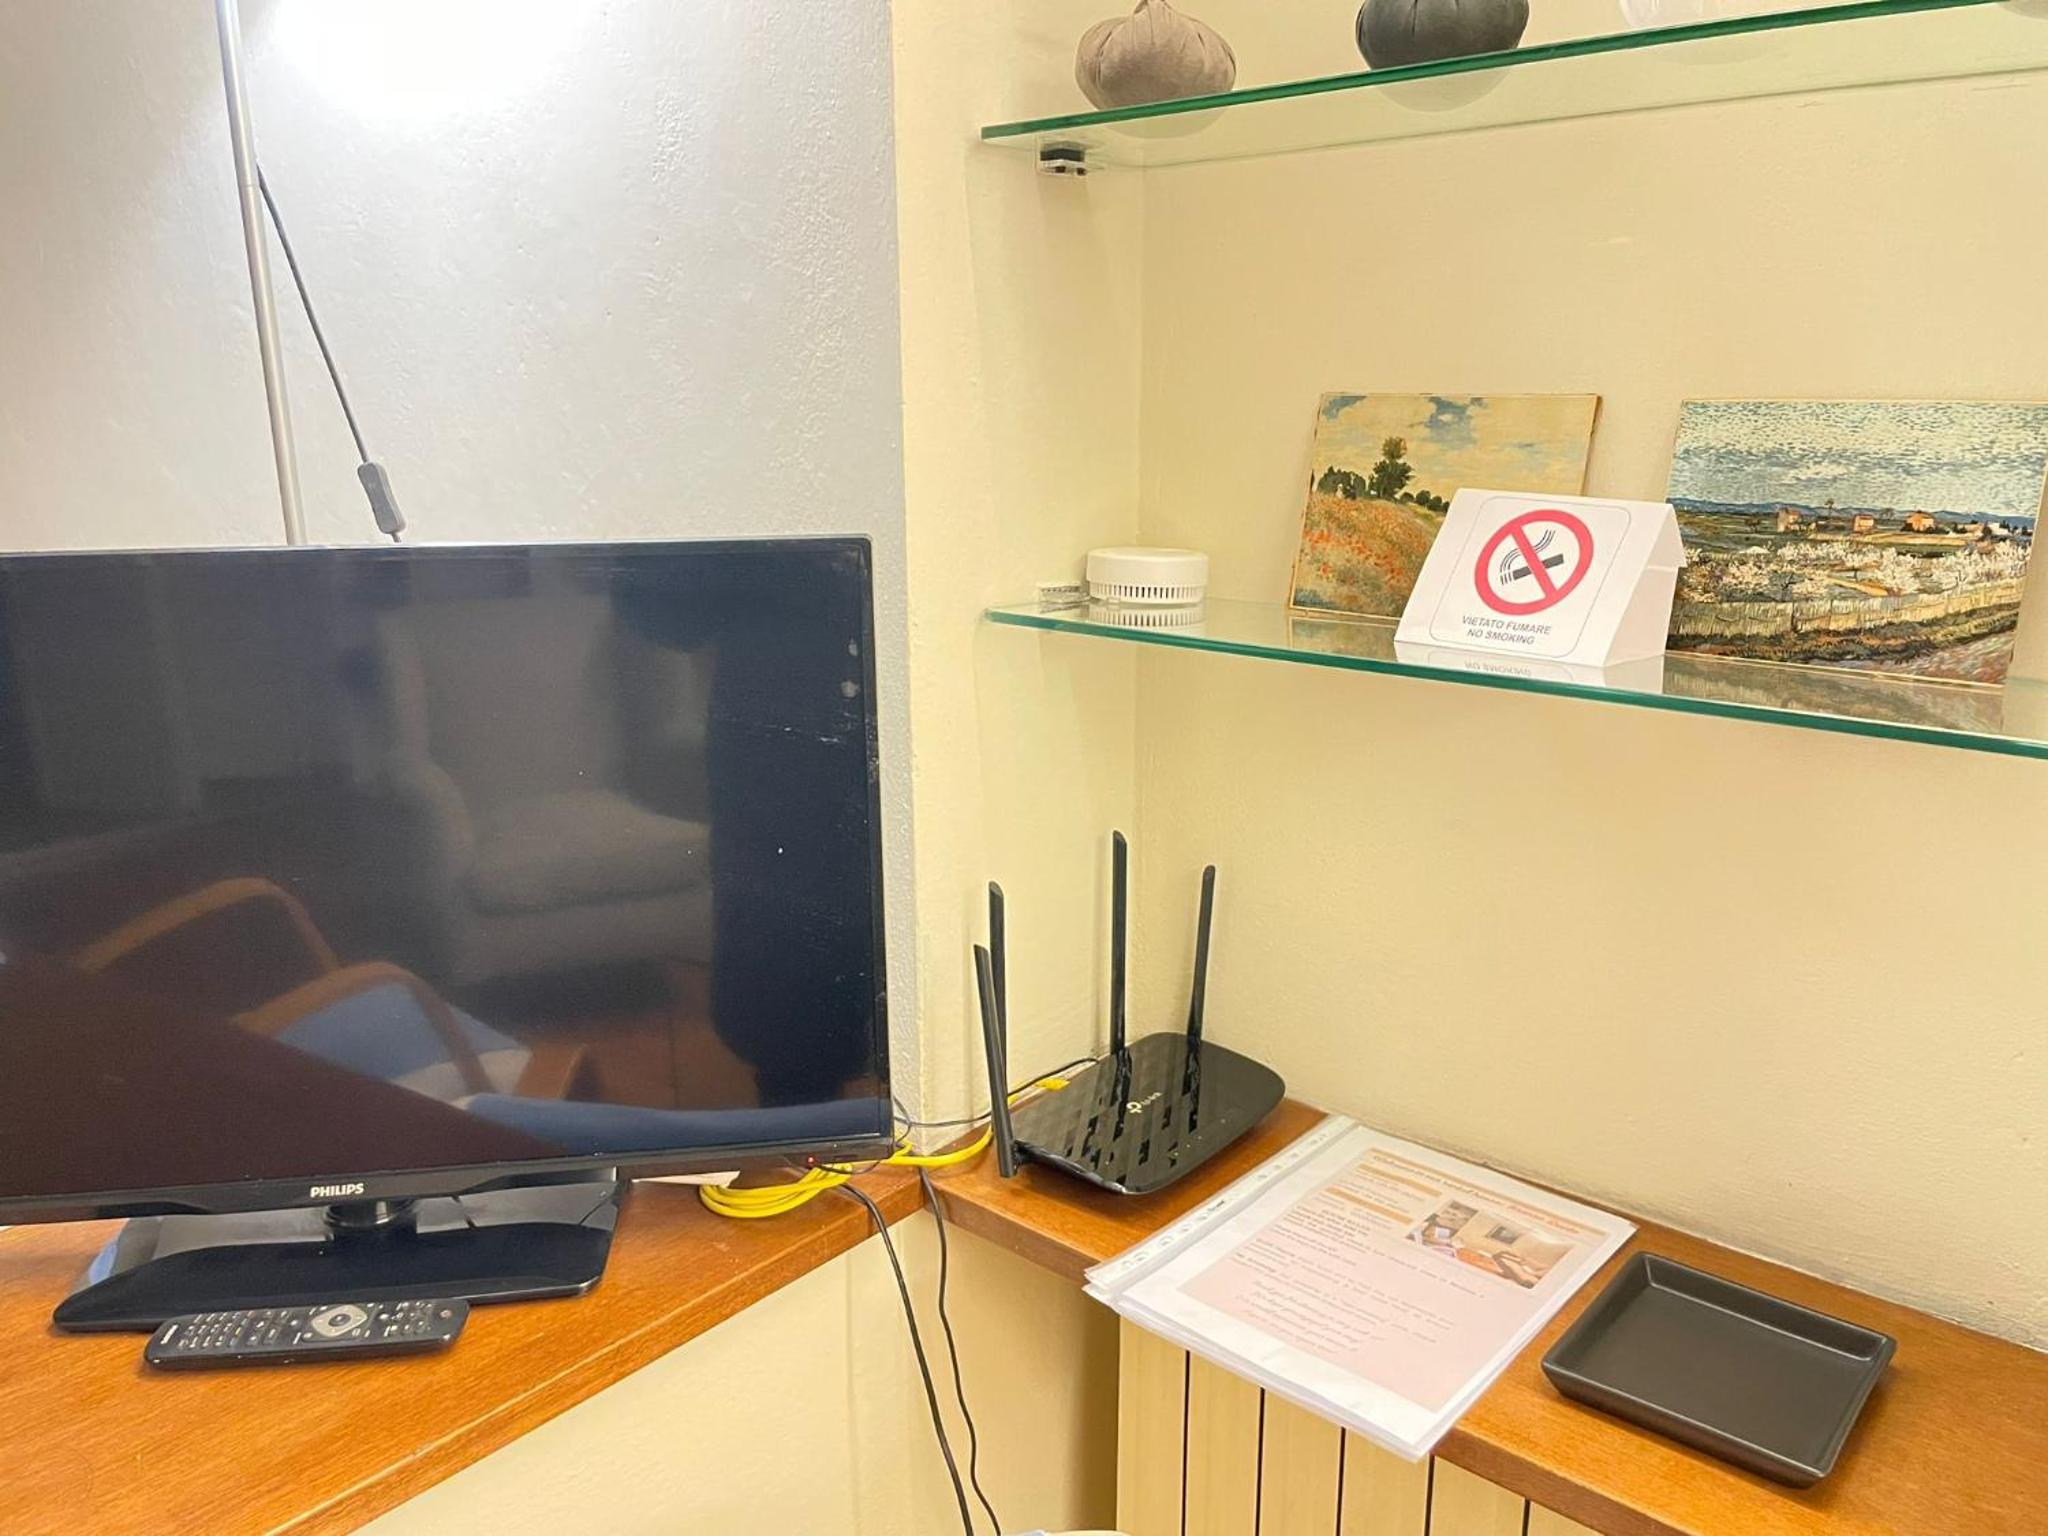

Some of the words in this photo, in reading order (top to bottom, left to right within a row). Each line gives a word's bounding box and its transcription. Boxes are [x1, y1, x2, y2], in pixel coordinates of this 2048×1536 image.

[1462, 616, 1504, 629] VIETATO
[1506, 621, 1551, 635] FUMARE
[1467, 628, 1483, 638] NO
[1485, 631, 1534, 644] SMOKING
[310, 1182, 364, 1198] PHILIPS
